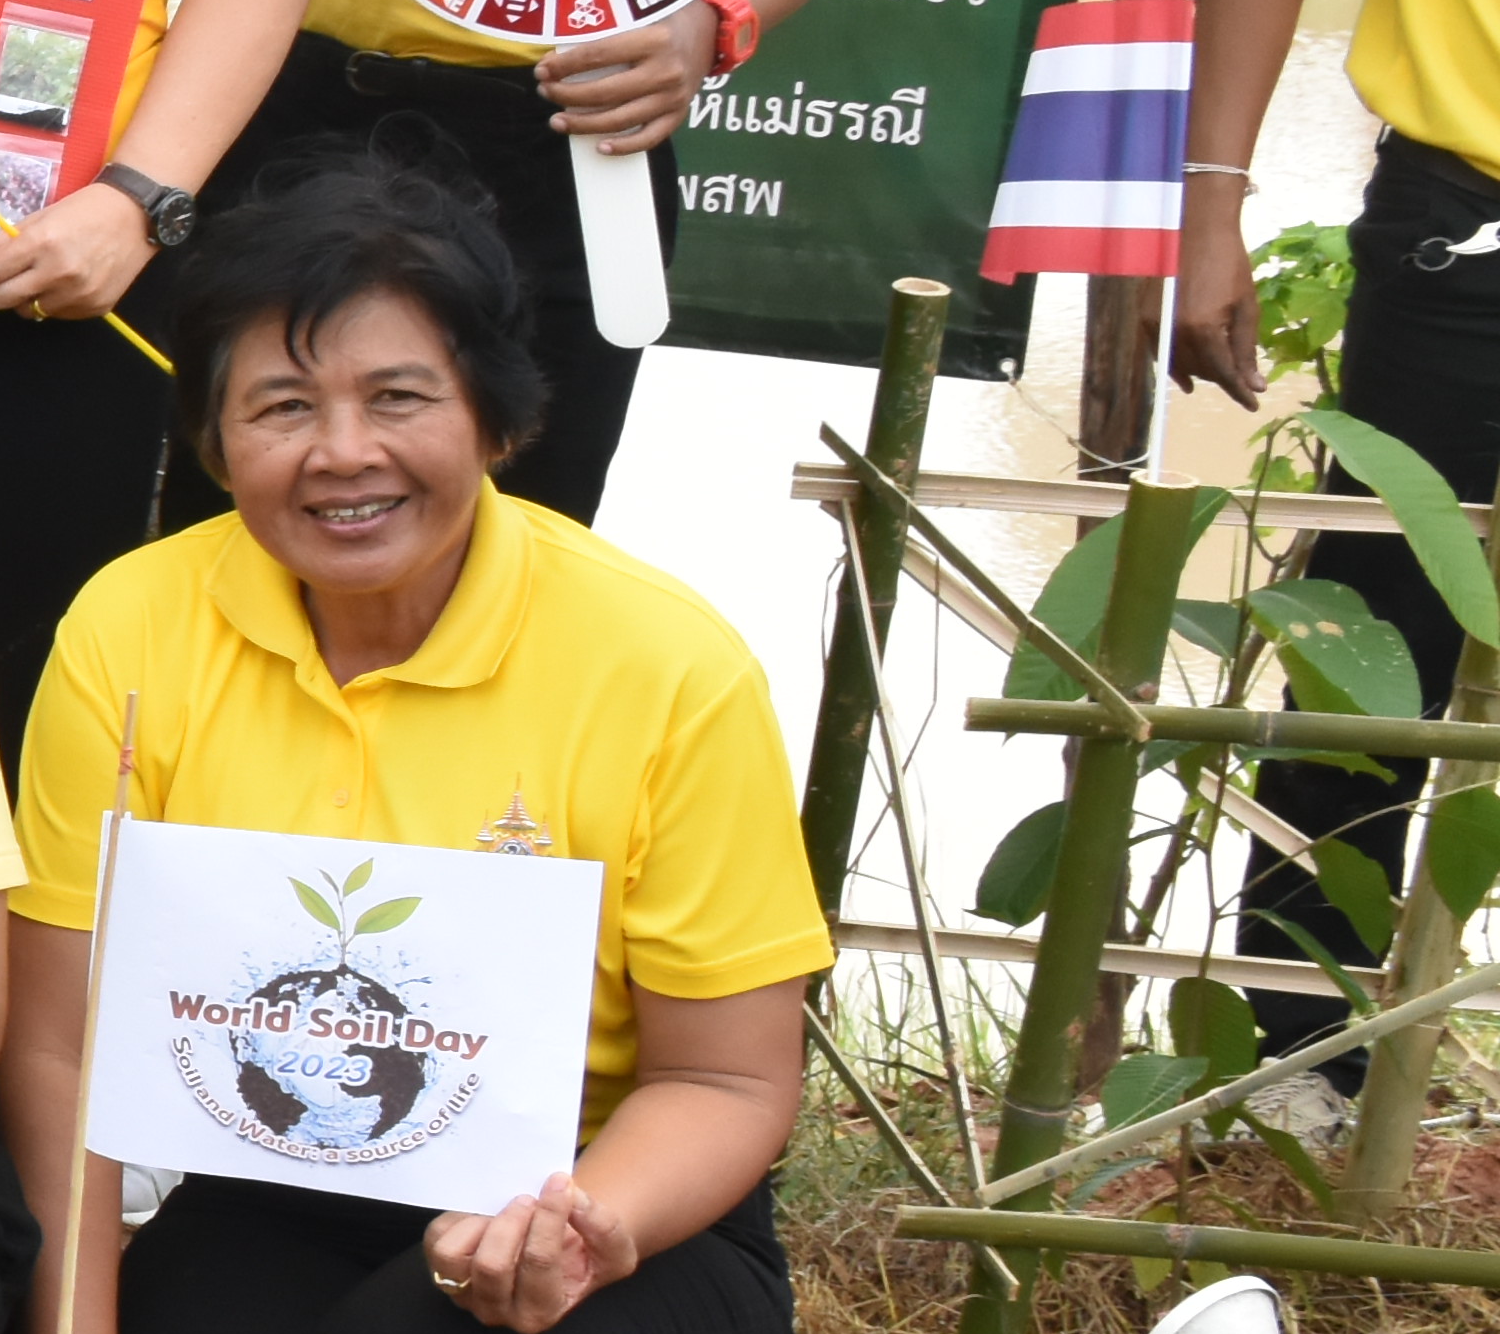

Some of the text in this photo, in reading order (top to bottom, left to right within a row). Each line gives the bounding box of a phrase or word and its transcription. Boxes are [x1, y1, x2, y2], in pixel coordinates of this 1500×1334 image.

[168, 990, 488, 1061] World Soil Day
[171, 1035, 483, 1163] Soil and Water: a source of life
[276, 1049, 373, 1084] 2023
